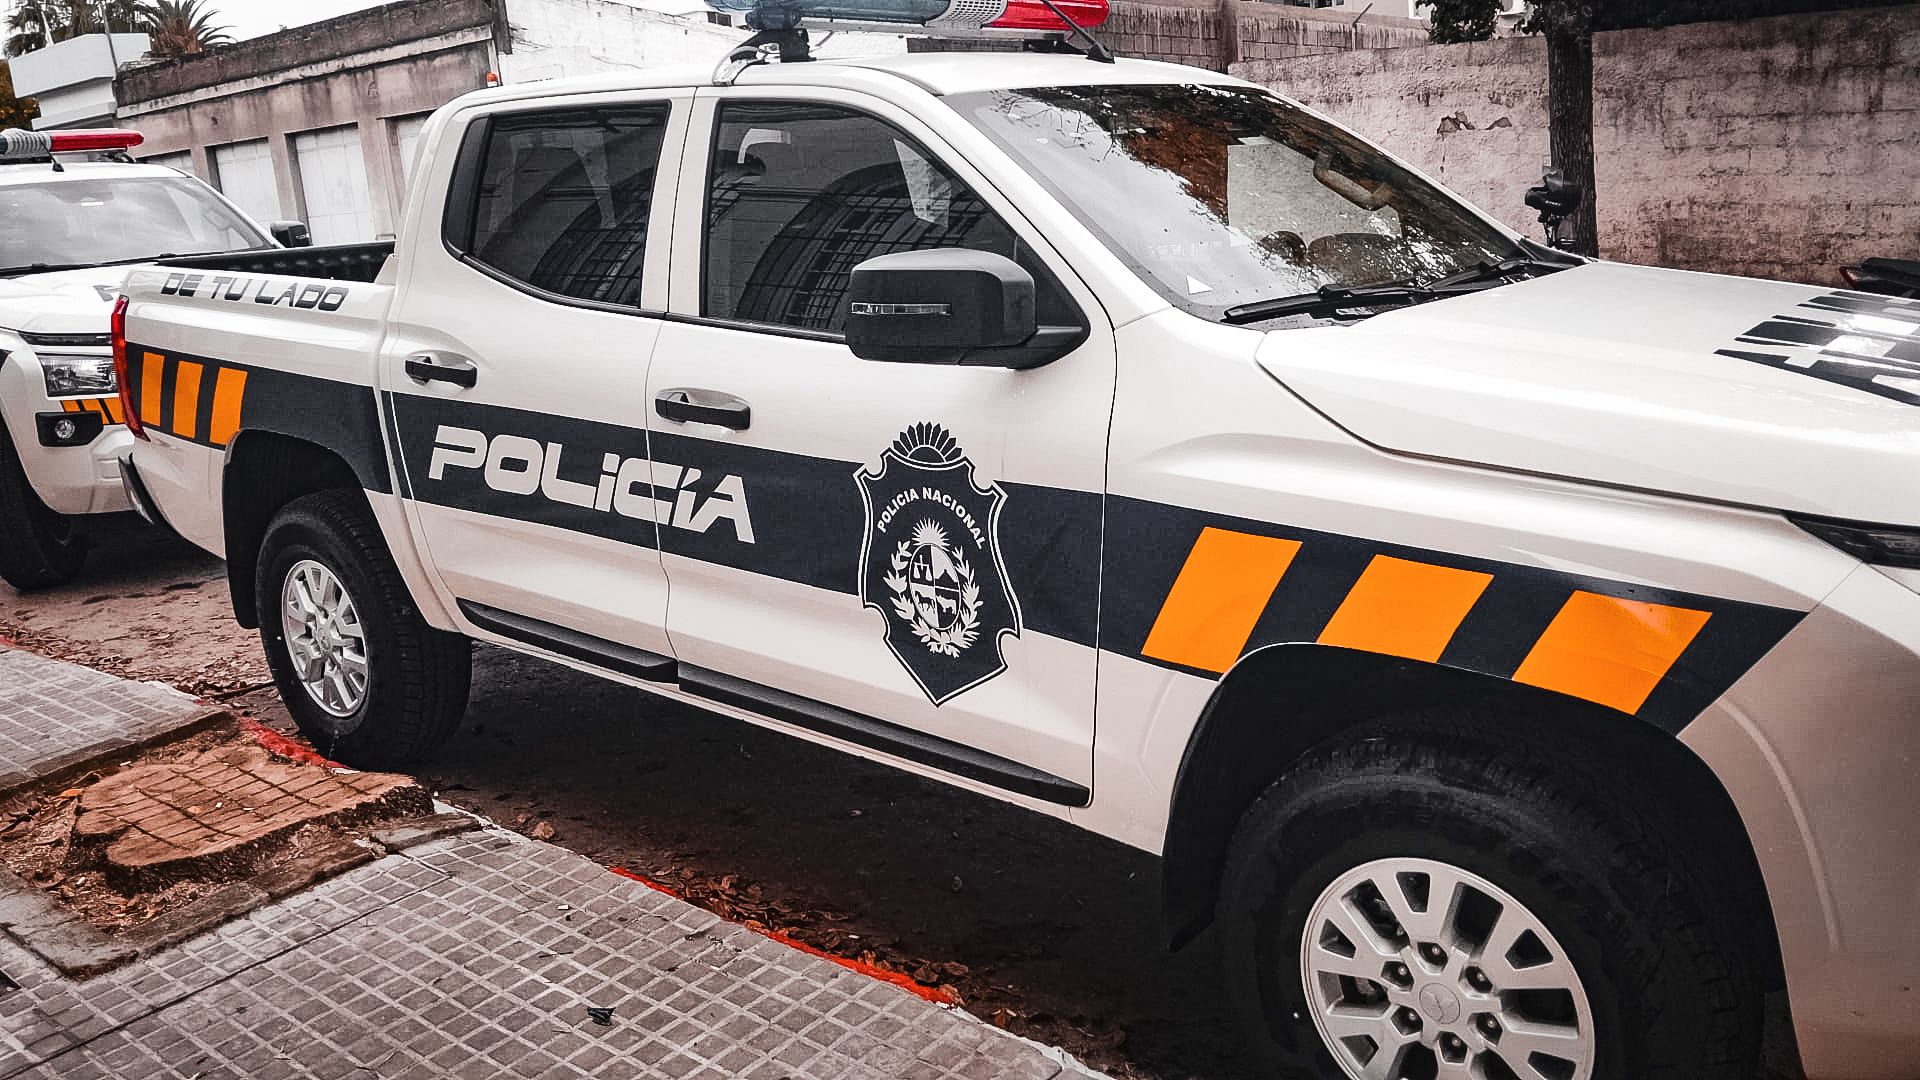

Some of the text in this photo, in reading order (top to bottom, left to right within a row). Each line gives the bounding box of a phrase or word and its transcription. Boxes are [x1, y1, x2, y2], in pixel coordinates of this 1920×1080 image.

[160, 273, 349, 311] DE TU LADO
[877, 487, 986, 550] POLICIA NACIONAL
